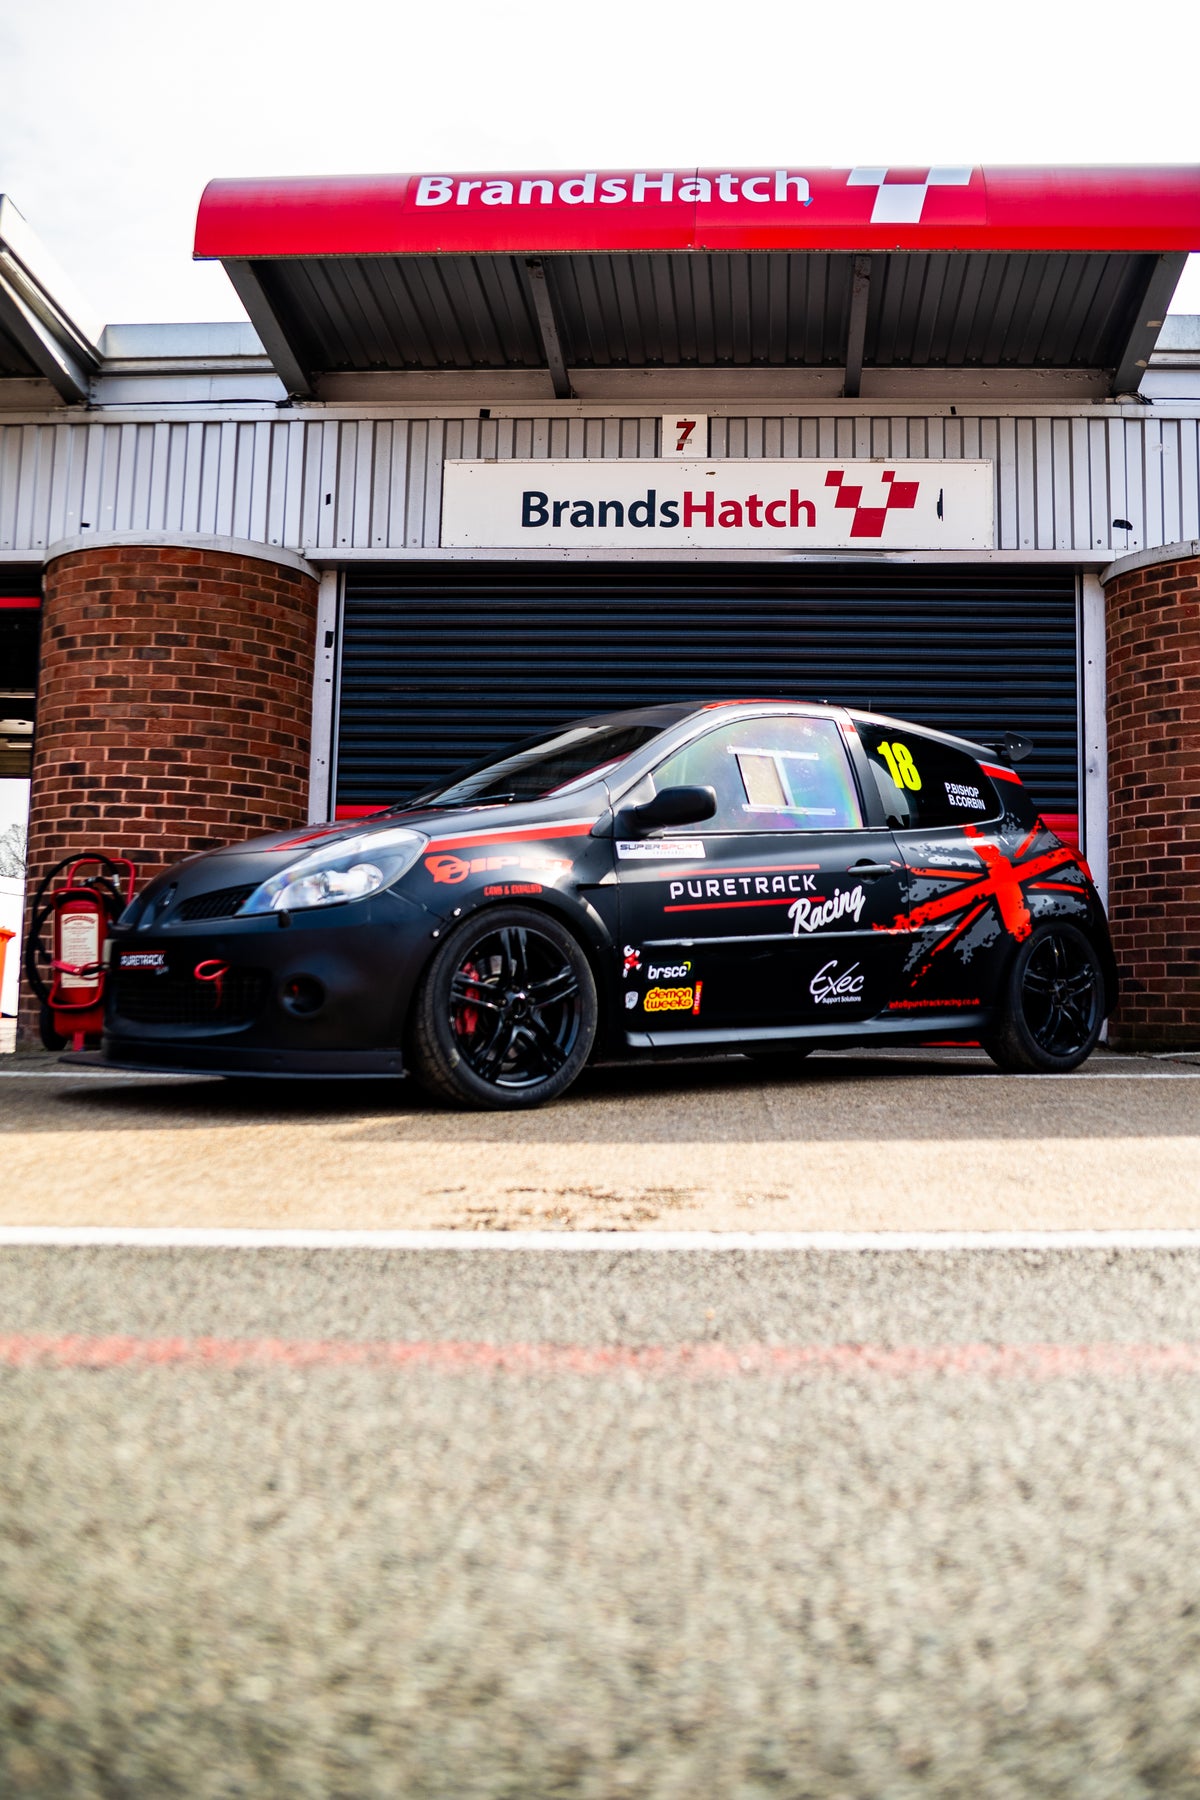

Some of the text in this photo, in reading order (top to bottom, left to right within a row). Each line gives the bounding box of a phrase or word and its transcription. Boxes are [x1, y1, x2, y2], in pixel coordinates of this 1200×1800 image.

[414, 170, 810, 206] BrandsHatch
[675, 421, 696, 451] 7
[521, 489, 817, 528] BrandsHatch
[877, 741, 922, 791] 18
[944, 781, 980, 798] P.BISHOP
[947, 794, 986, 811] B.CORBIN
[669, 874, 817, 899] PURETRACK
[787, 885, 867, 938] Racing
[648, 965, 688, 980] brscc
[809, 960, 865, 1004] Exec
[646, 999, 693, 1010] tweeks
[648, 987, 692, 1000] demon
